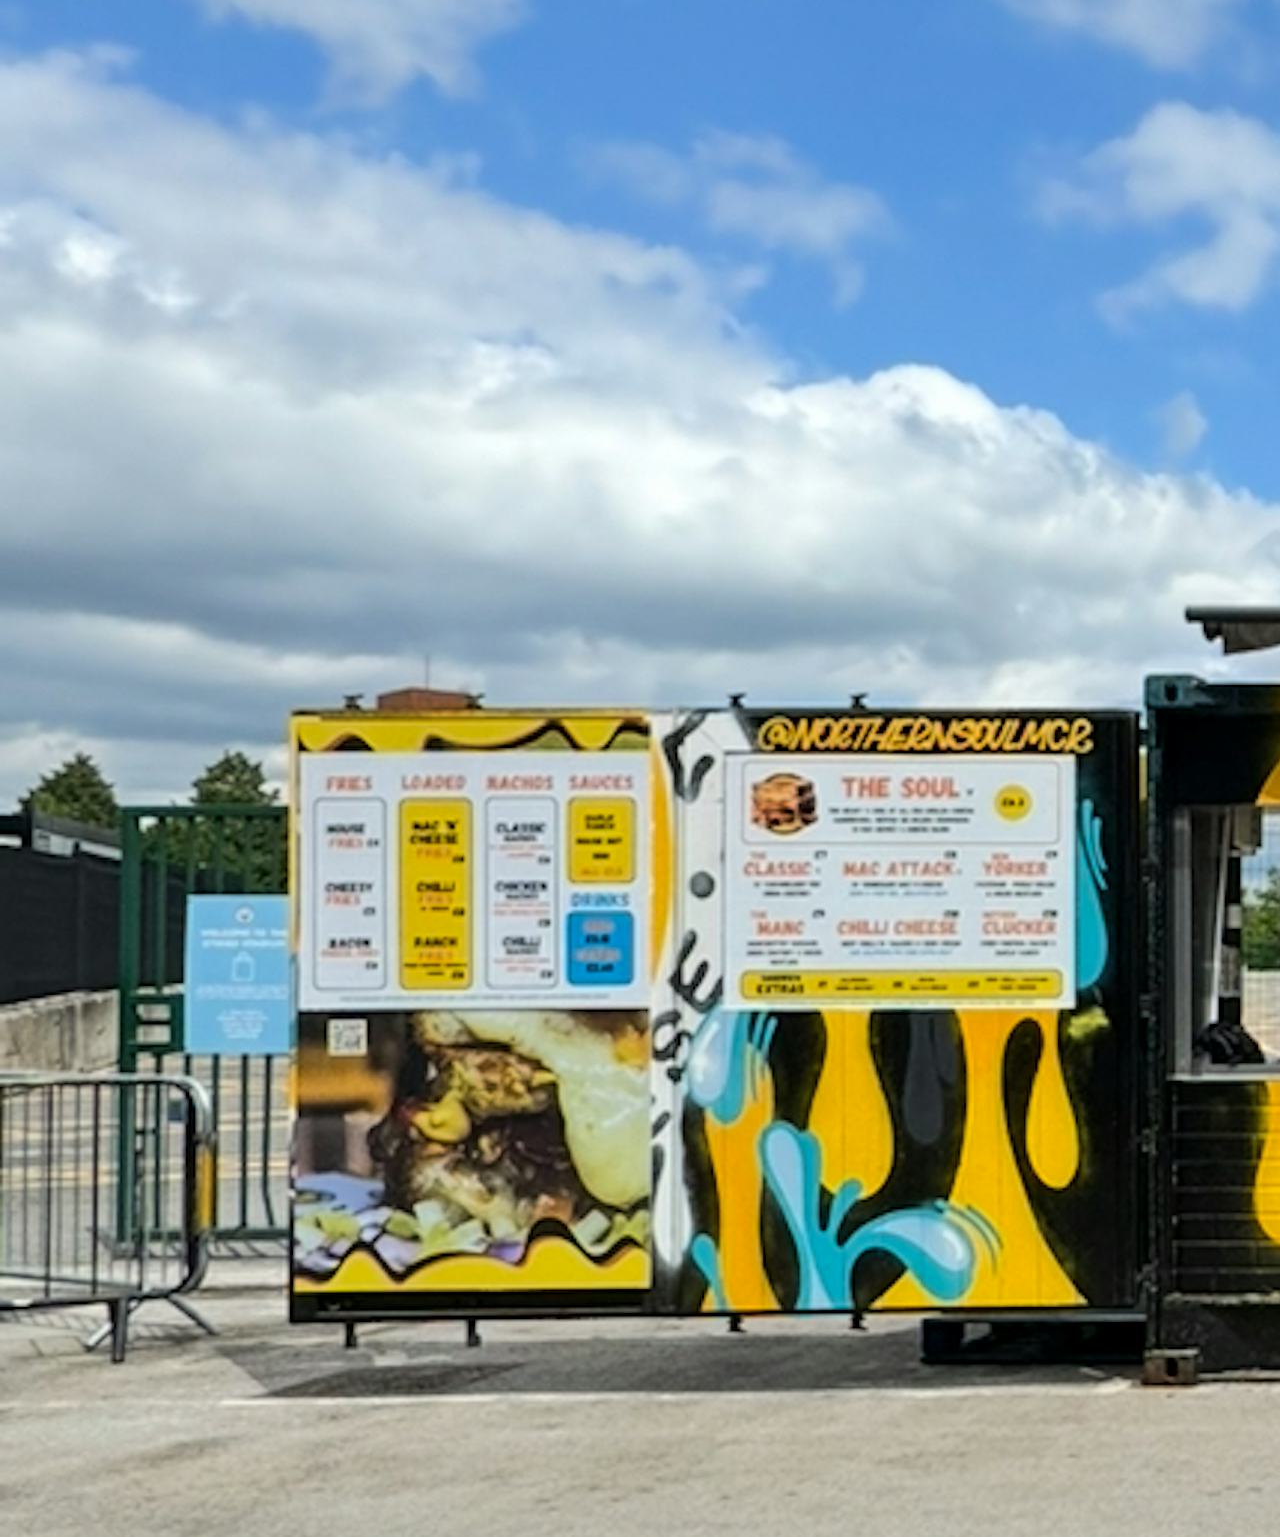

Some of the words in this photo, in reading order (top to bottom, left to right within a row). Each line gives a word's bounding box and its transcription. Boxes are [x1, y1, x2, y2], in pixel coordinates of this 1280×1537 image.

[758, 716, 1094, 753] @NORTHERNSOULMCR
[326, 776, 372, 790] FRIES
[402, 776, 466, 790] LOADED
[487, 776, 553, 790] NACHOS
[569, 775, 633, 790] SAUCES
[842, 776, 890, 798] THE
[901, 776, 960, 798] SOUL
[326, 823, 365, 833] HOUSE
[412, 820, 438, 830] MAC
[496, 823, 546, 834] CLASSIC
[329, 837, 364, 848] FRIES
[410, 834, 458, 844] CHEESE
[743, 861, 811, 876] CLASSIC
[843, 861, 881, 876] MAC
[886, 861, 954, 876] ATTACK
[983, 861, 1048, 876] YORKER
[325, 882, 374, 893] CHEESY
[416, 882, 456, 893] CHILLI
[495, 881, 548, 892] CHICKEN
[325, 894, 360, 905] FRIES
[571, 893, 631, 907] DRINKS
[757, 920, 804, 935] MANC
[837, 920, 889, 935] CHILLI
[893, 920, 956, 935] CHEESE
[982, 920, 1057, 935] CLUCKER
[329, 938, 371, 948] BACON
[414, 937, 458, 947] RANCH
[502, 937, 541, 947] CHILLI
[756, 983, 804, 994] EXTRAS
